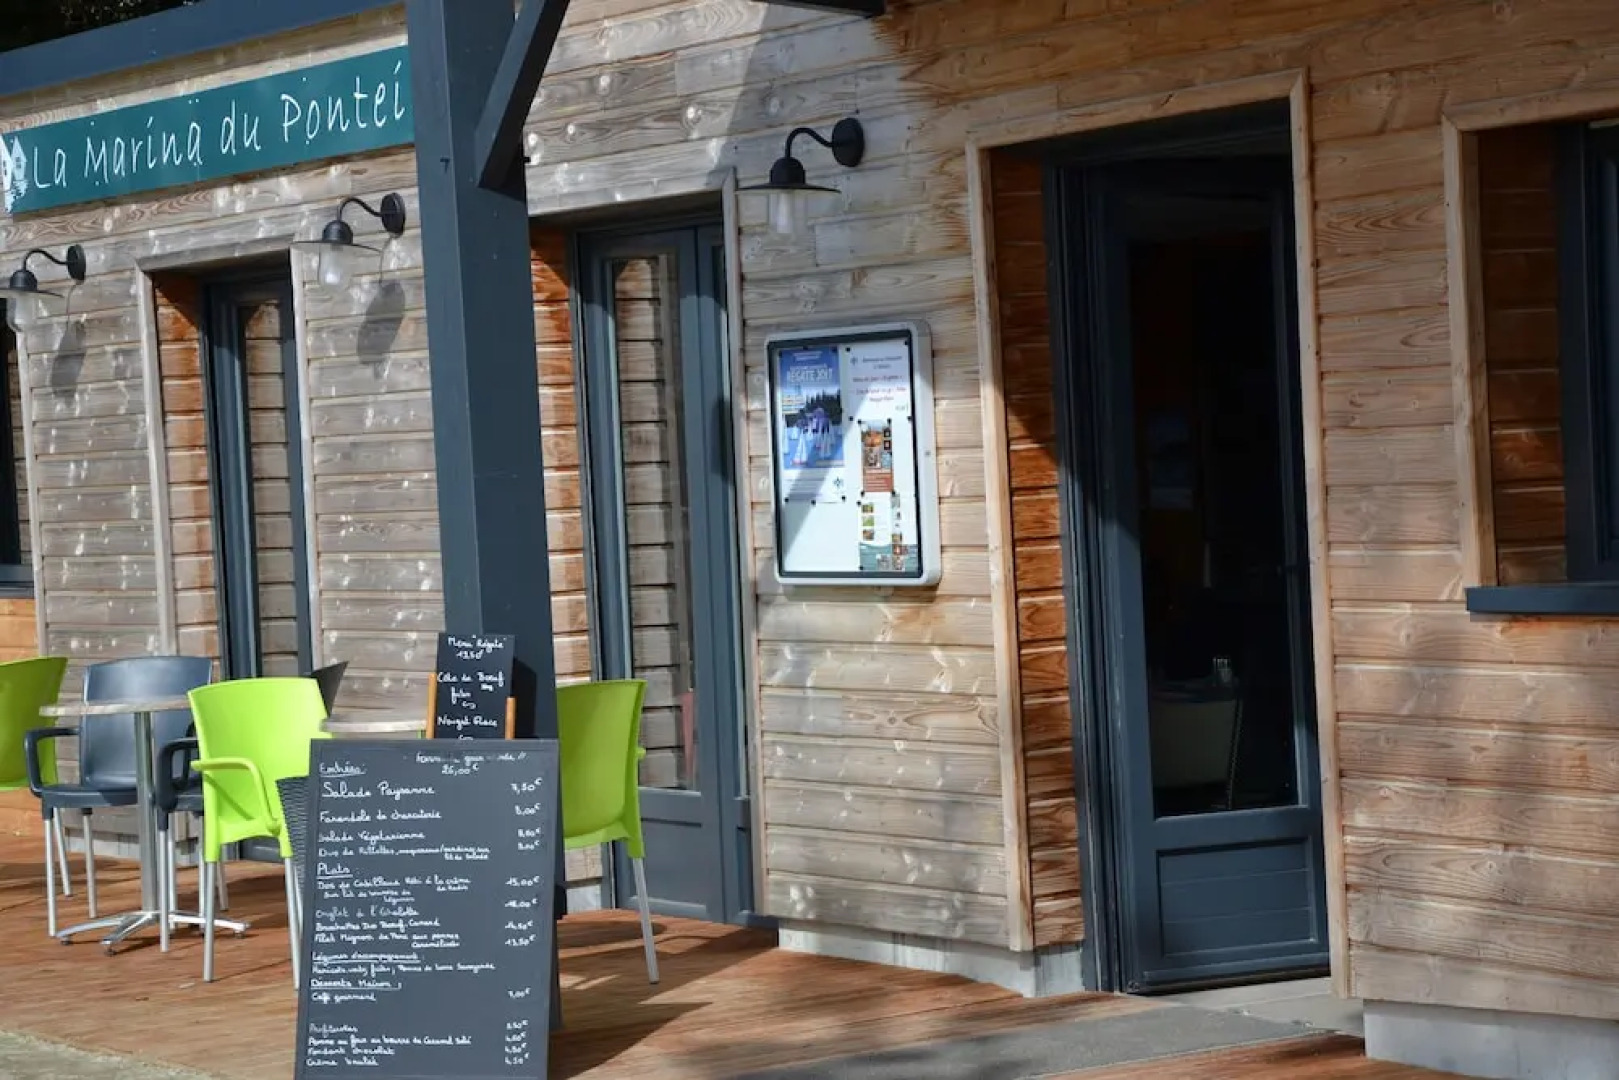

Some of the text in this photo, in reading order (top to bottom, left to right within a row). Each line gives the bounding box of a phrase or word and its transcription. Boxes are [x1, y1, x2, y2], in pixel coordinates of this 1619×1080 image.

[33, 146, 67, 188] La
[83, 116, 204, 183] Marina
[221, 100, 262, 155] du
[322, 781, 435, 801] Salade Paysanne
